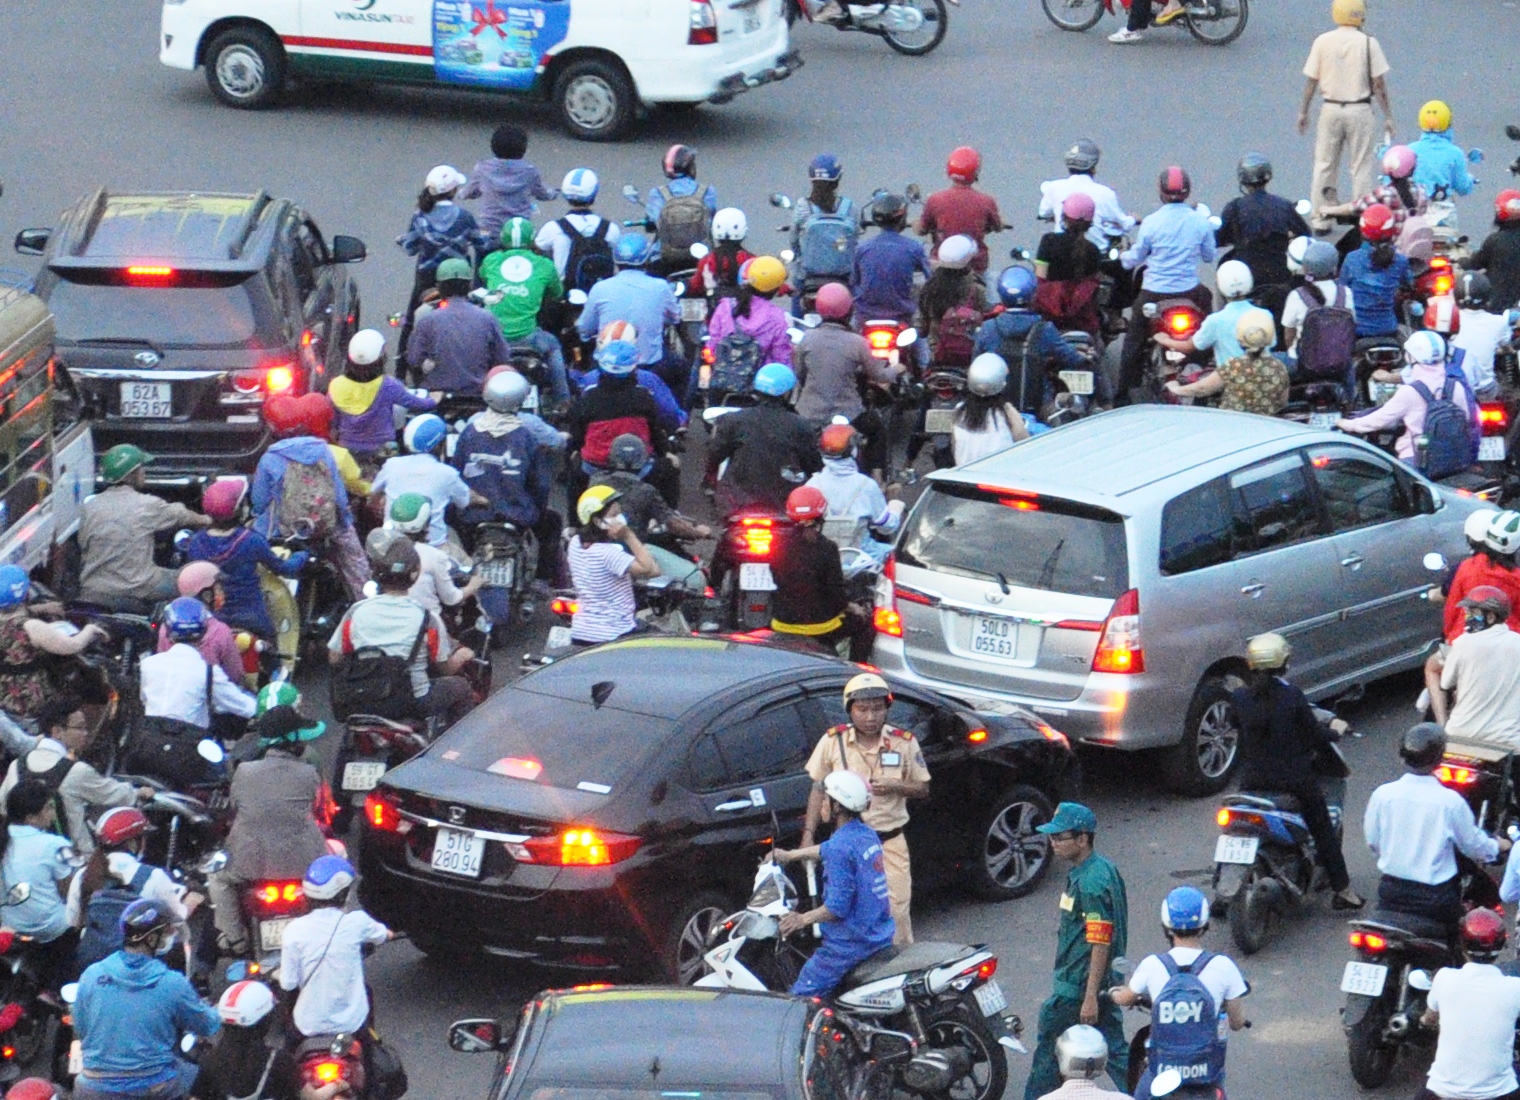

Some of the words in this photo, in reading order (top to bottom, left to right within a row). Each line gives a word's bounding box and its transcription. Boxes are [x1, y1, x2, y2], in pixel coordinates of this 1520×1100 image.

[132, 385, 159, 400] 62A
[981, 619, 1009, 637] 50LD
[1159, 1001, 1204, 1024] BOY
